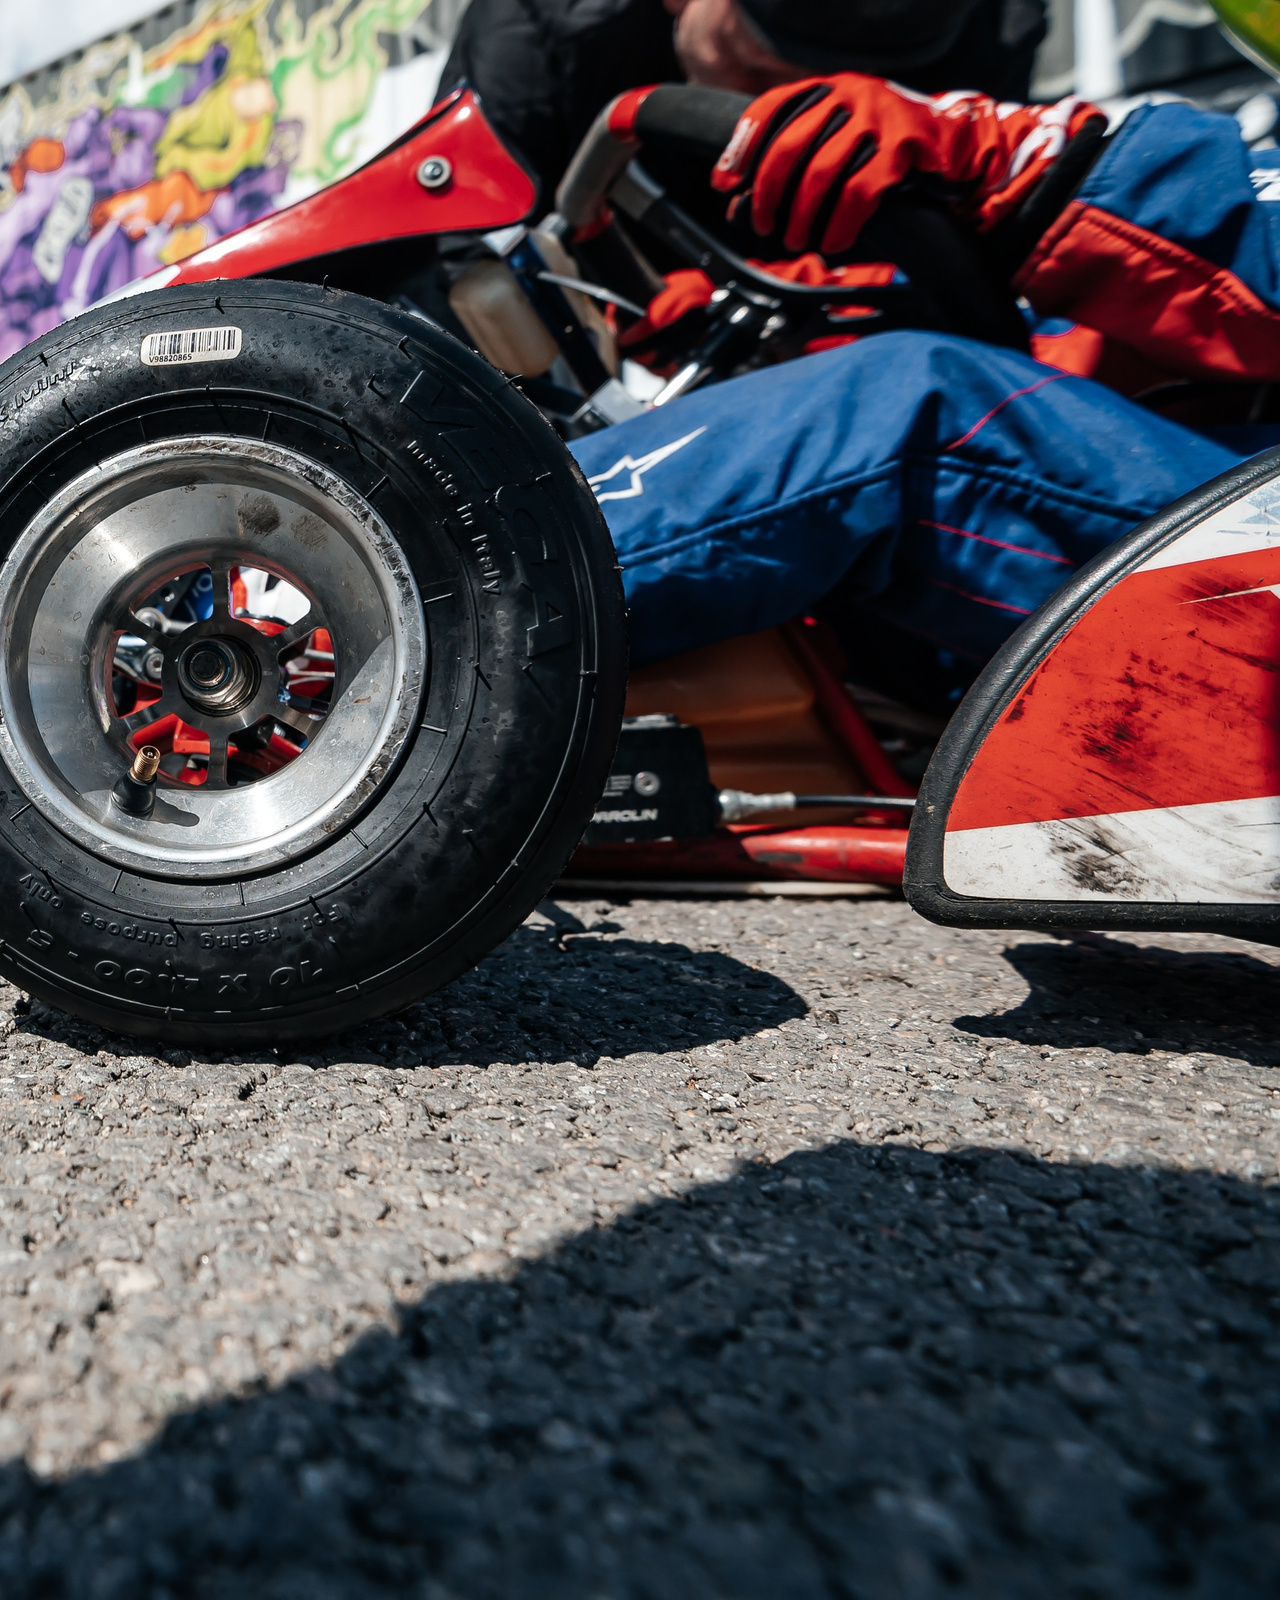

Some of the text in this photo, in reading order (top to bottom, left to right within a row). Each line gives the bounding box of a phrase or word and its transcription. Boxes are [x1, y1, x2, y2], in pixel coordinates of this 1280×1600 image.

[149, 354, 192, 363] V98820865
[400, 370, 573, 660] VEGA
[407, 440, 501, 595] made in Italy
[19, 873, 345, 950] For racing purpose only
[26, 929, 55, 949] 5
[269, 960, 323, 989] 10
